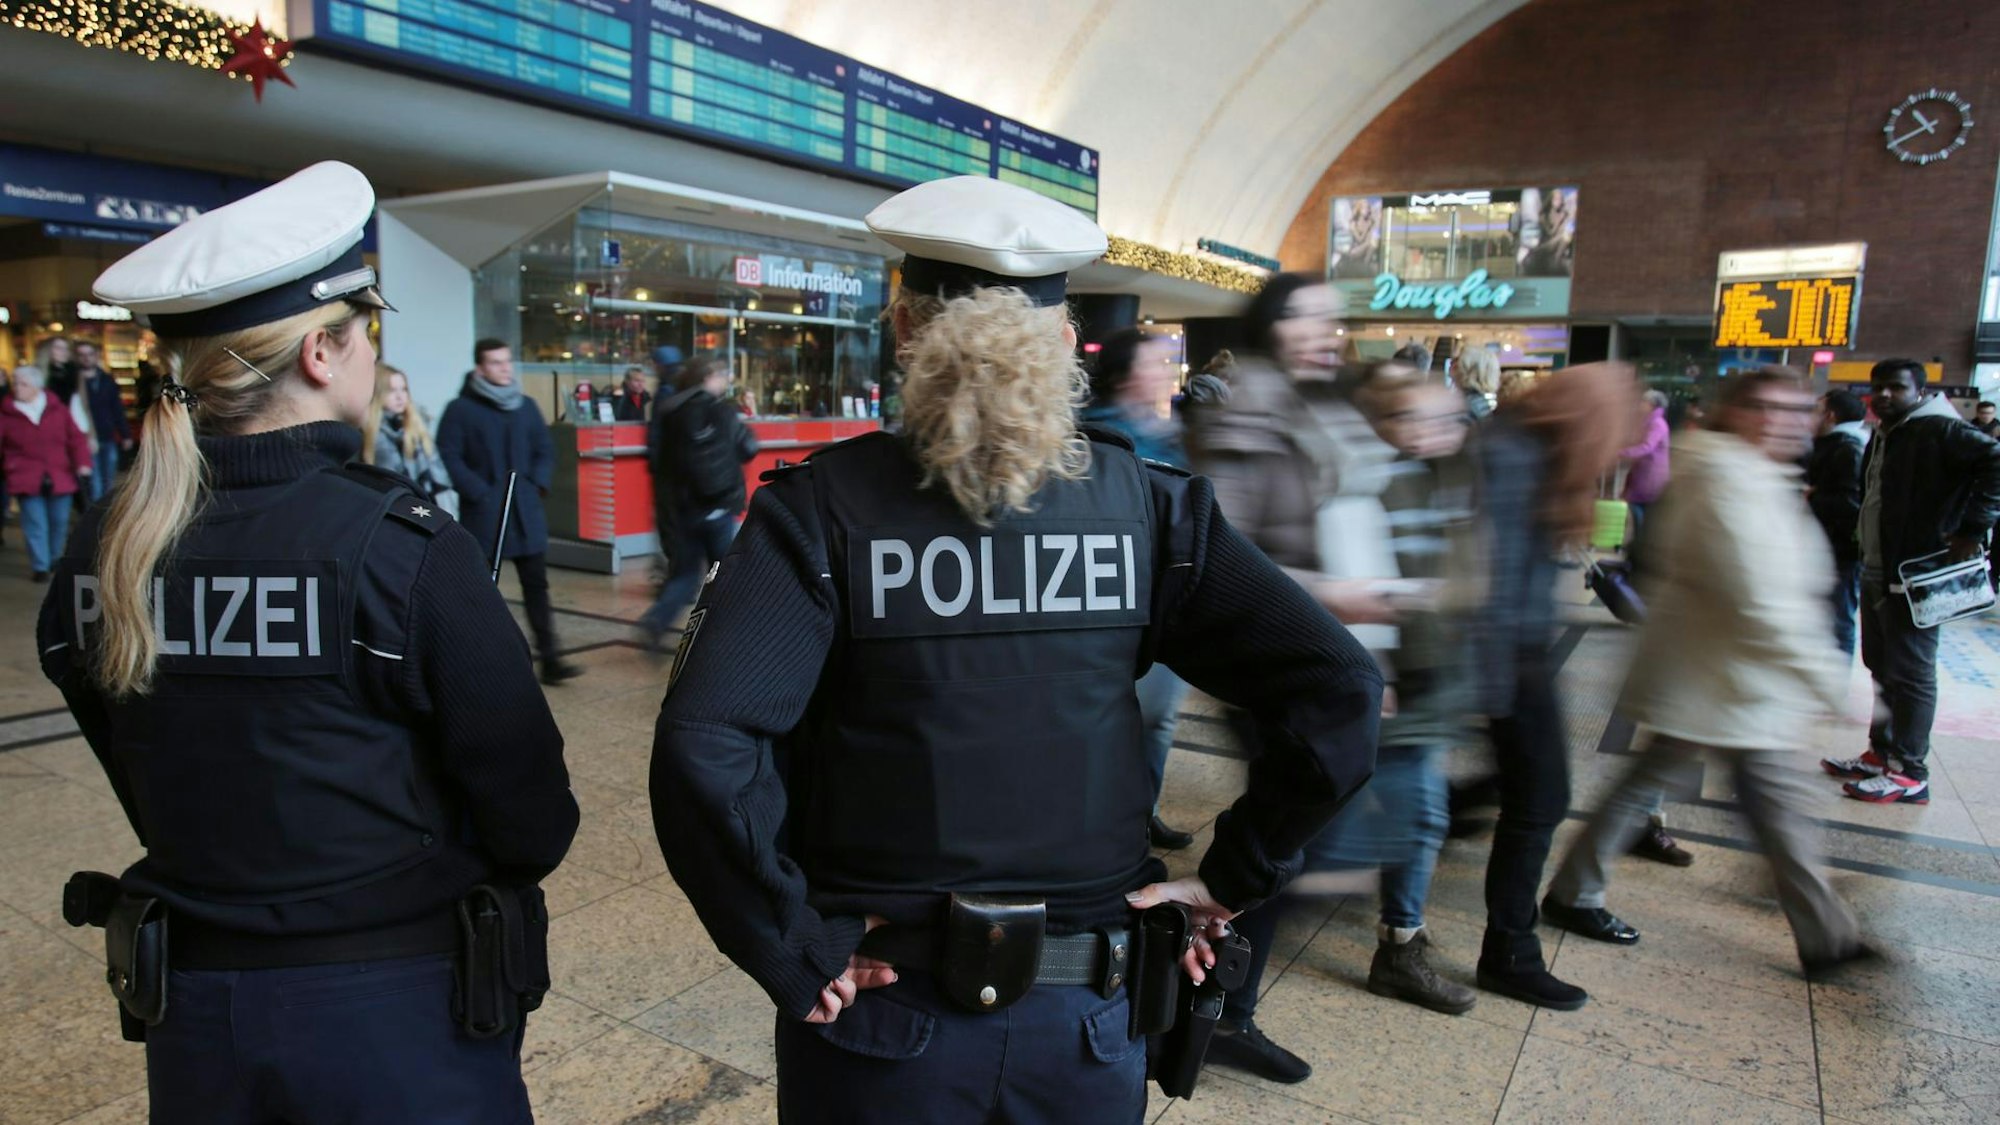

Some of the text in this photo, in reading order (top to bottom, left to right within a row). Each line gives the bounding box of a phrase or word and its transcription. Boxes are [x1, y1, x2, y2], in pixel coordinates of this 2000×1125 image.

[768, 262, 863, 297] Information
[1369, 268, 1515, 320] Douglas
[870, 535, 1137, 619] POLIZEI
[74, 575, 321, 657] PLIZEI
